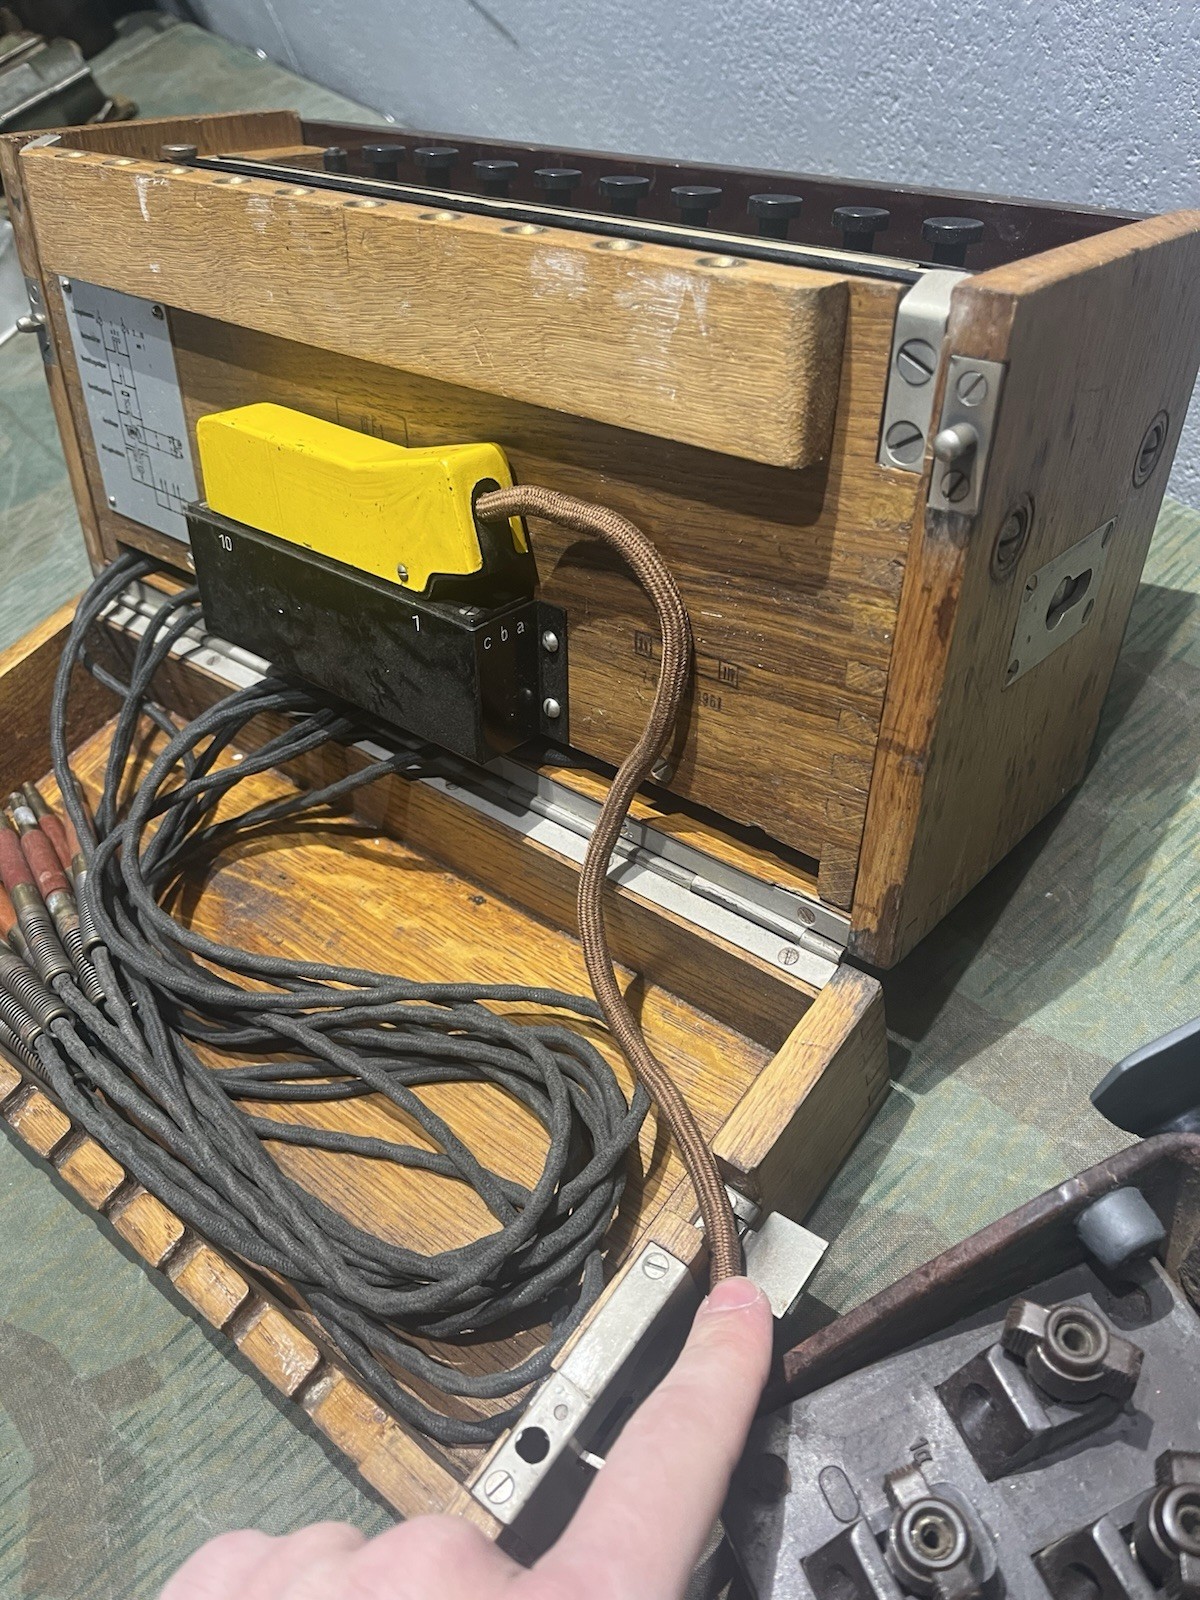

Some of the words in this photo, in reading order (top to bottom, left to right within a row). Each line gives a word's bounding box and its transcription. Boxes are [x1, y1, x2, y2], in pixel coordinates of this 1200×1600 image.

[218, 534, 233, 551] 10
[411, 614, 421, 632] 1
[483, 636, 492, 650] c
[500, 625, 509, 642] b
[516, 621, 525, 635] a
